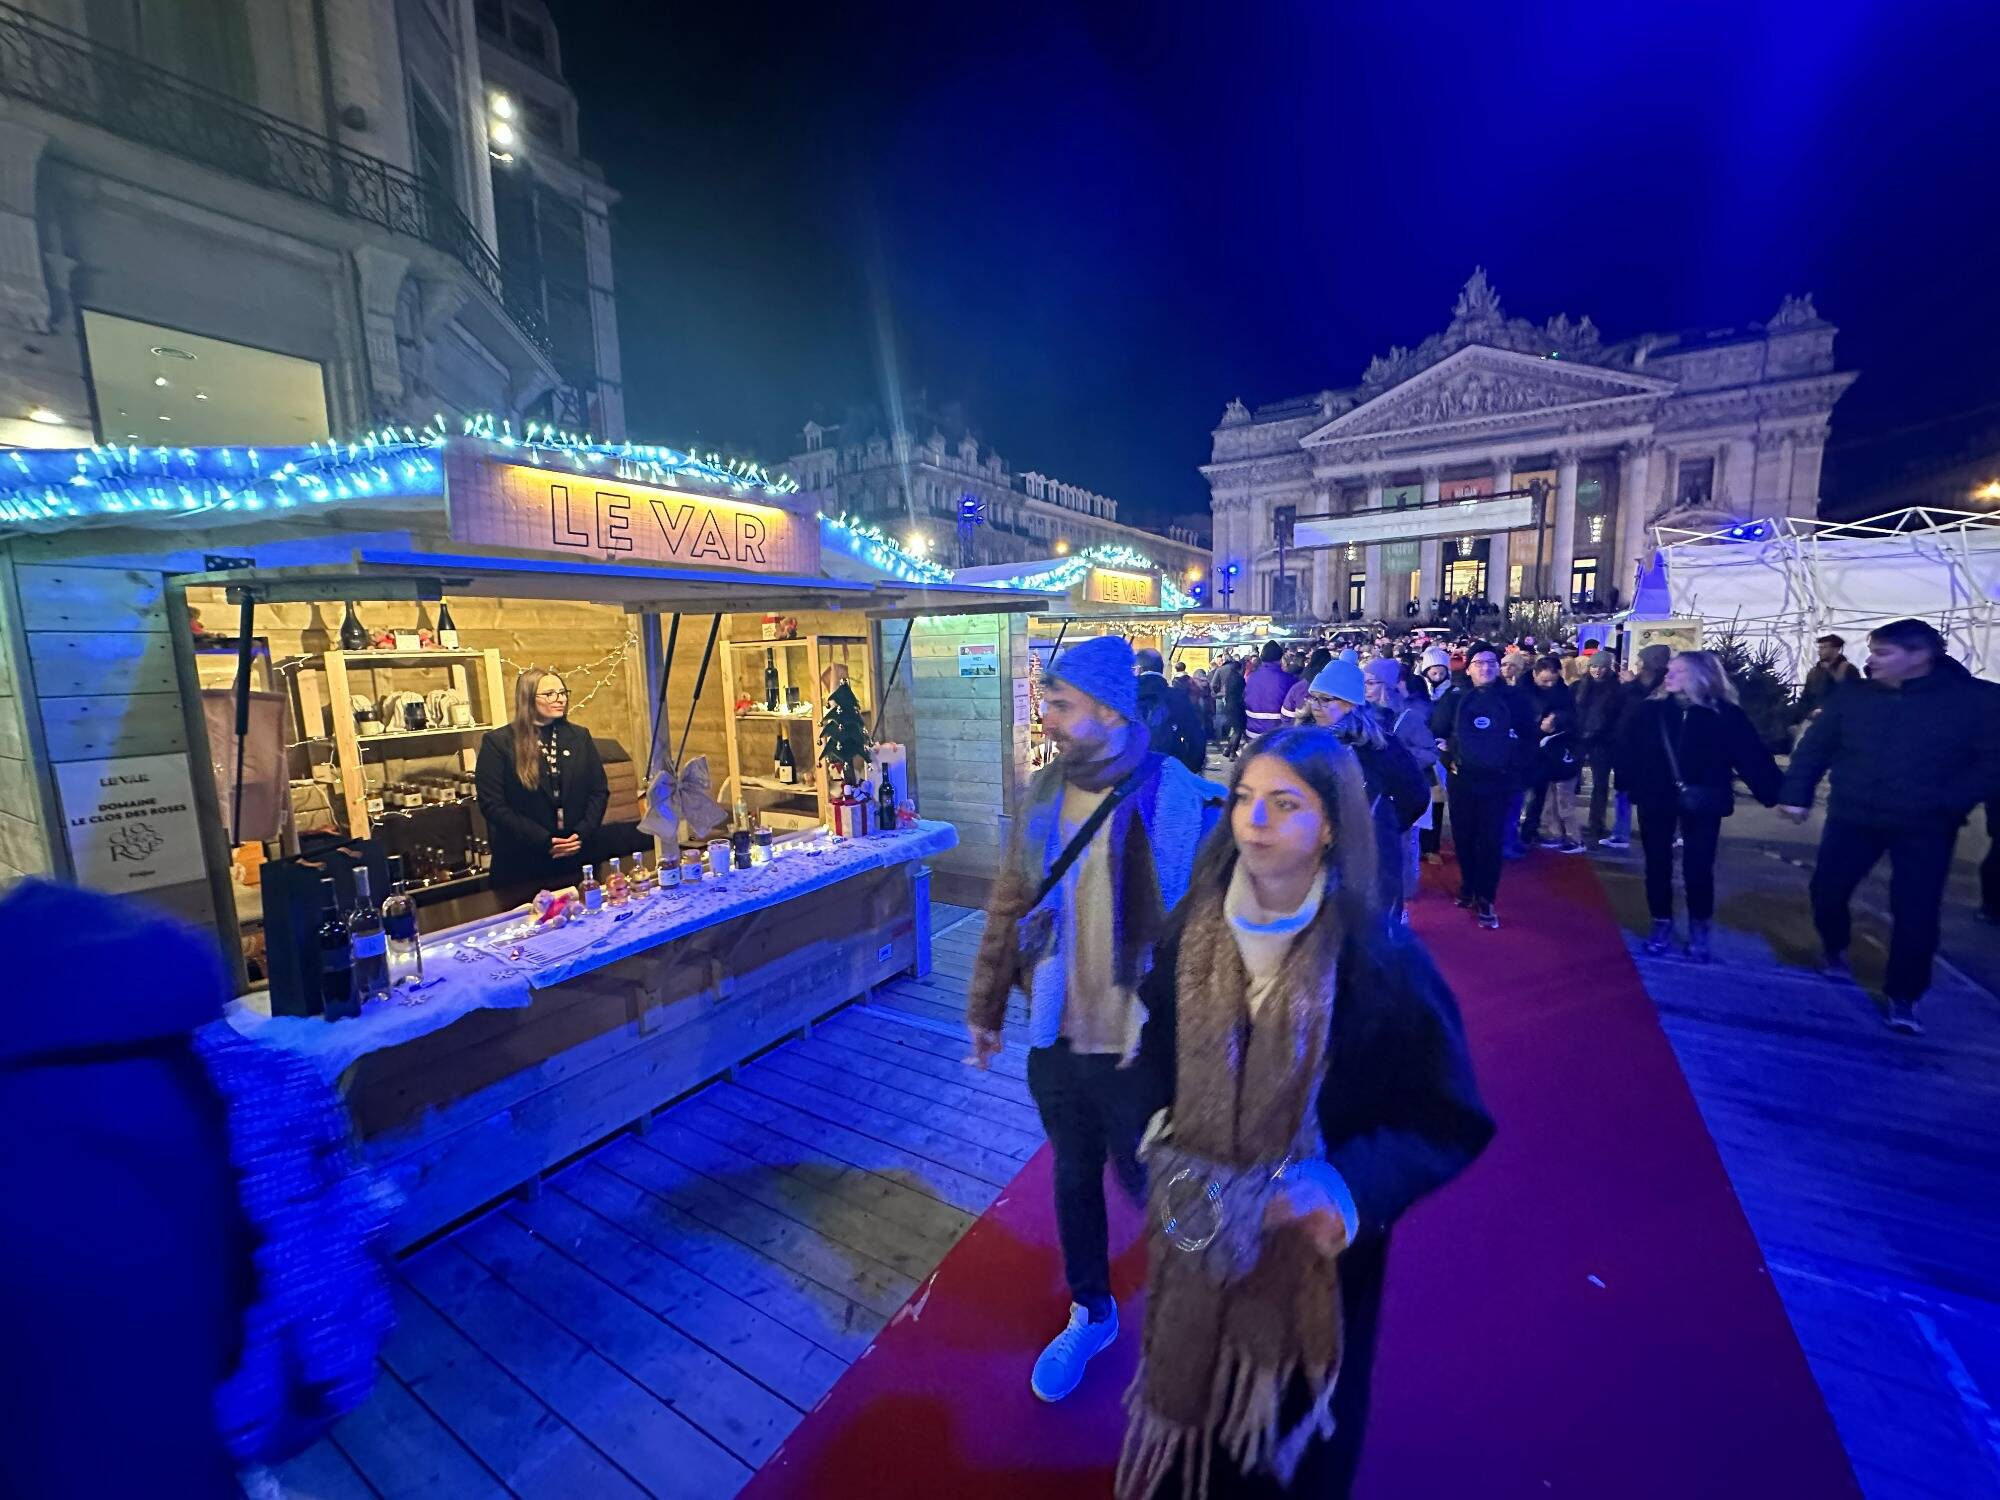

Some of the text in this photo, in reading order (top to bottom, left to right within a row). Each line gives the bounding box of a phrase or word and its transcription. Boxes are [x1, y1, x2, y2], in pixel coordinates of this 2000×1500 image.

[551, 485, 766, 564] LE VAR
[1103, 575, 1147, 604] LE VAR
[71, 804, 187, 826] LE CLOS DES ROSES
[98, 798, 157, 811] DOMAINE
